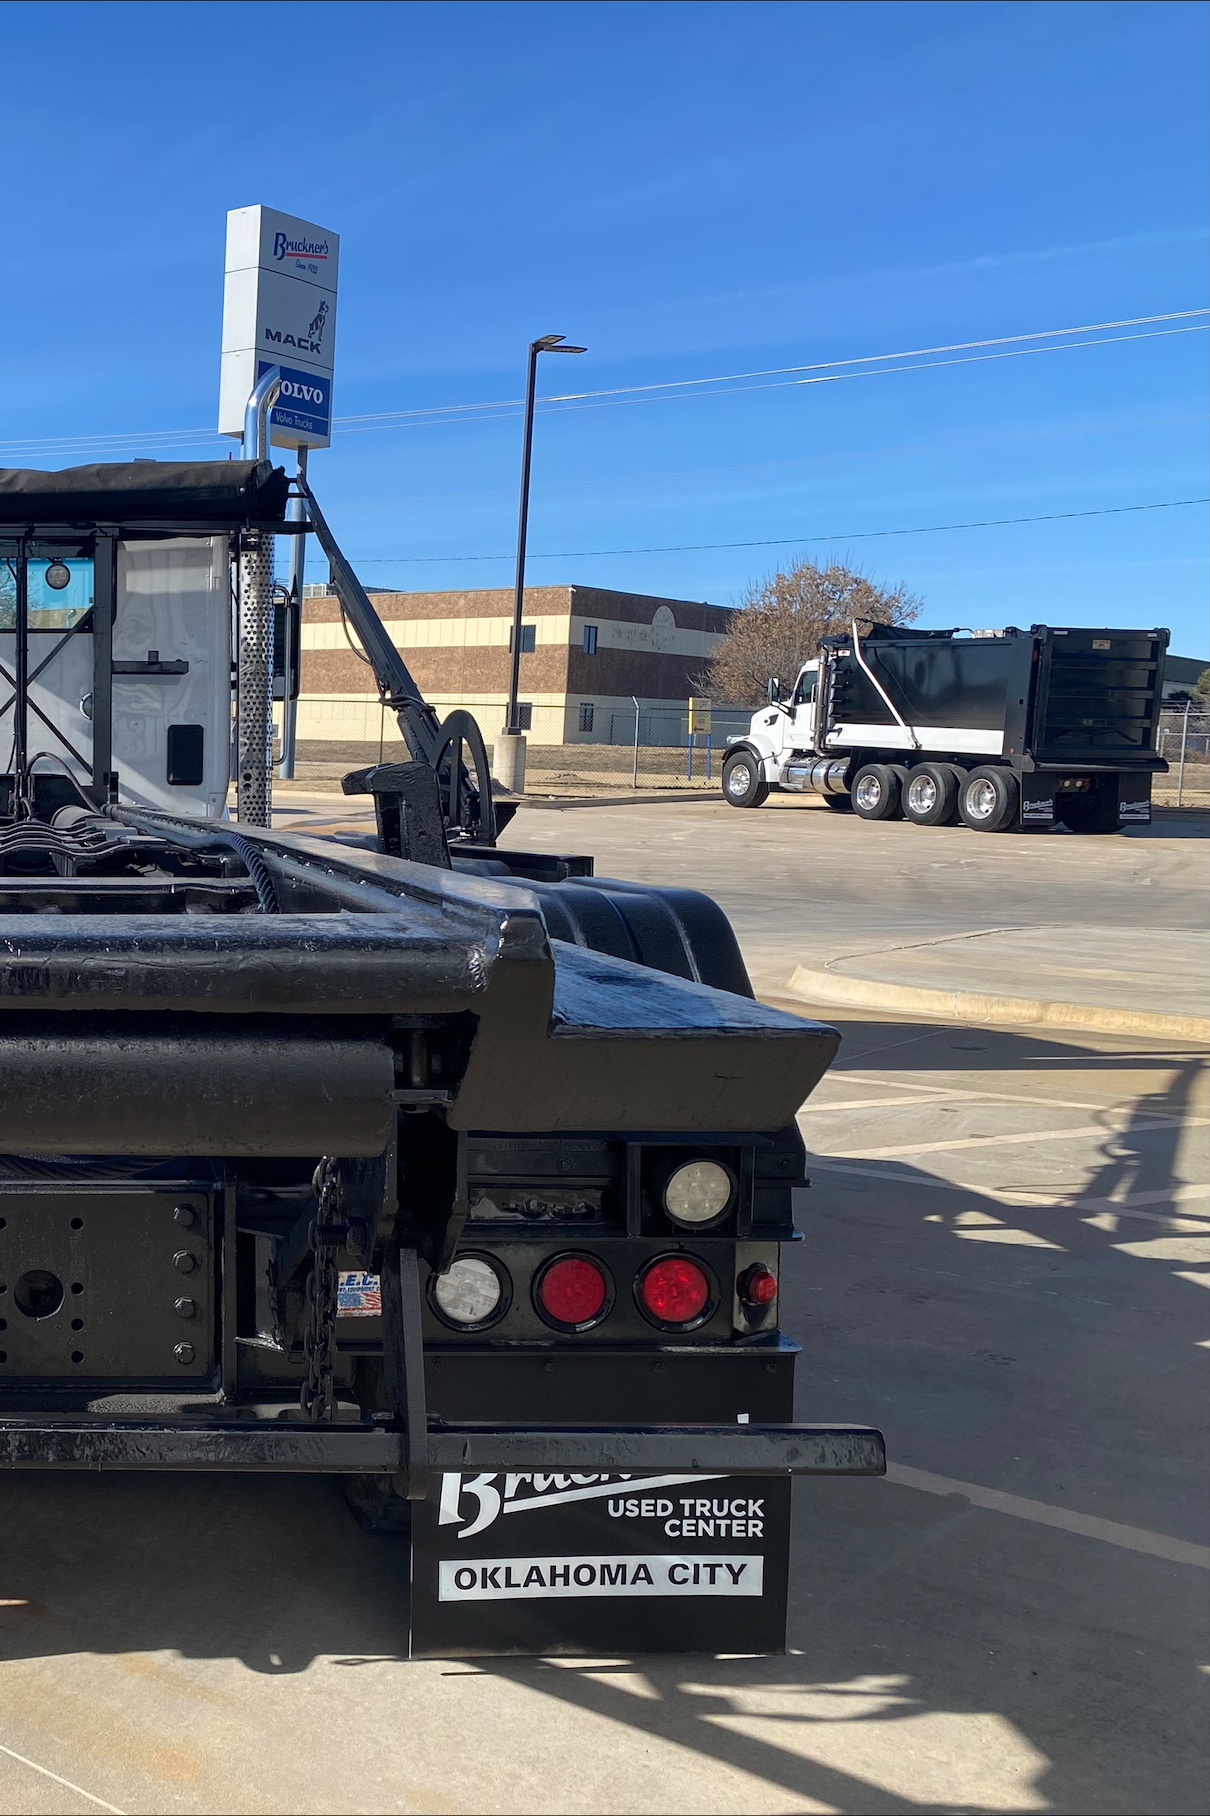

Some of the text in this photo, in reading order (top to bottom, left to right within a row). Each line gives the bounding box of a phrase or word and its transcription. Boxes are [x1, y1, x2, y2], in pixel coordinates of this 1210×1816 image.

[273, 232, 329, 260] Bruckner's
[265, 328, 321, 354] MACK
[280, 380, 324, 404] OLVO
[275, 411, 313, 430] Volvo Trucks
[608, 1499, 765, 1518] USED TRUCK
[664, 1519, 764, 1538] CENTER
[454, 1563, 747, 1591] OKLAHOMA CITY
